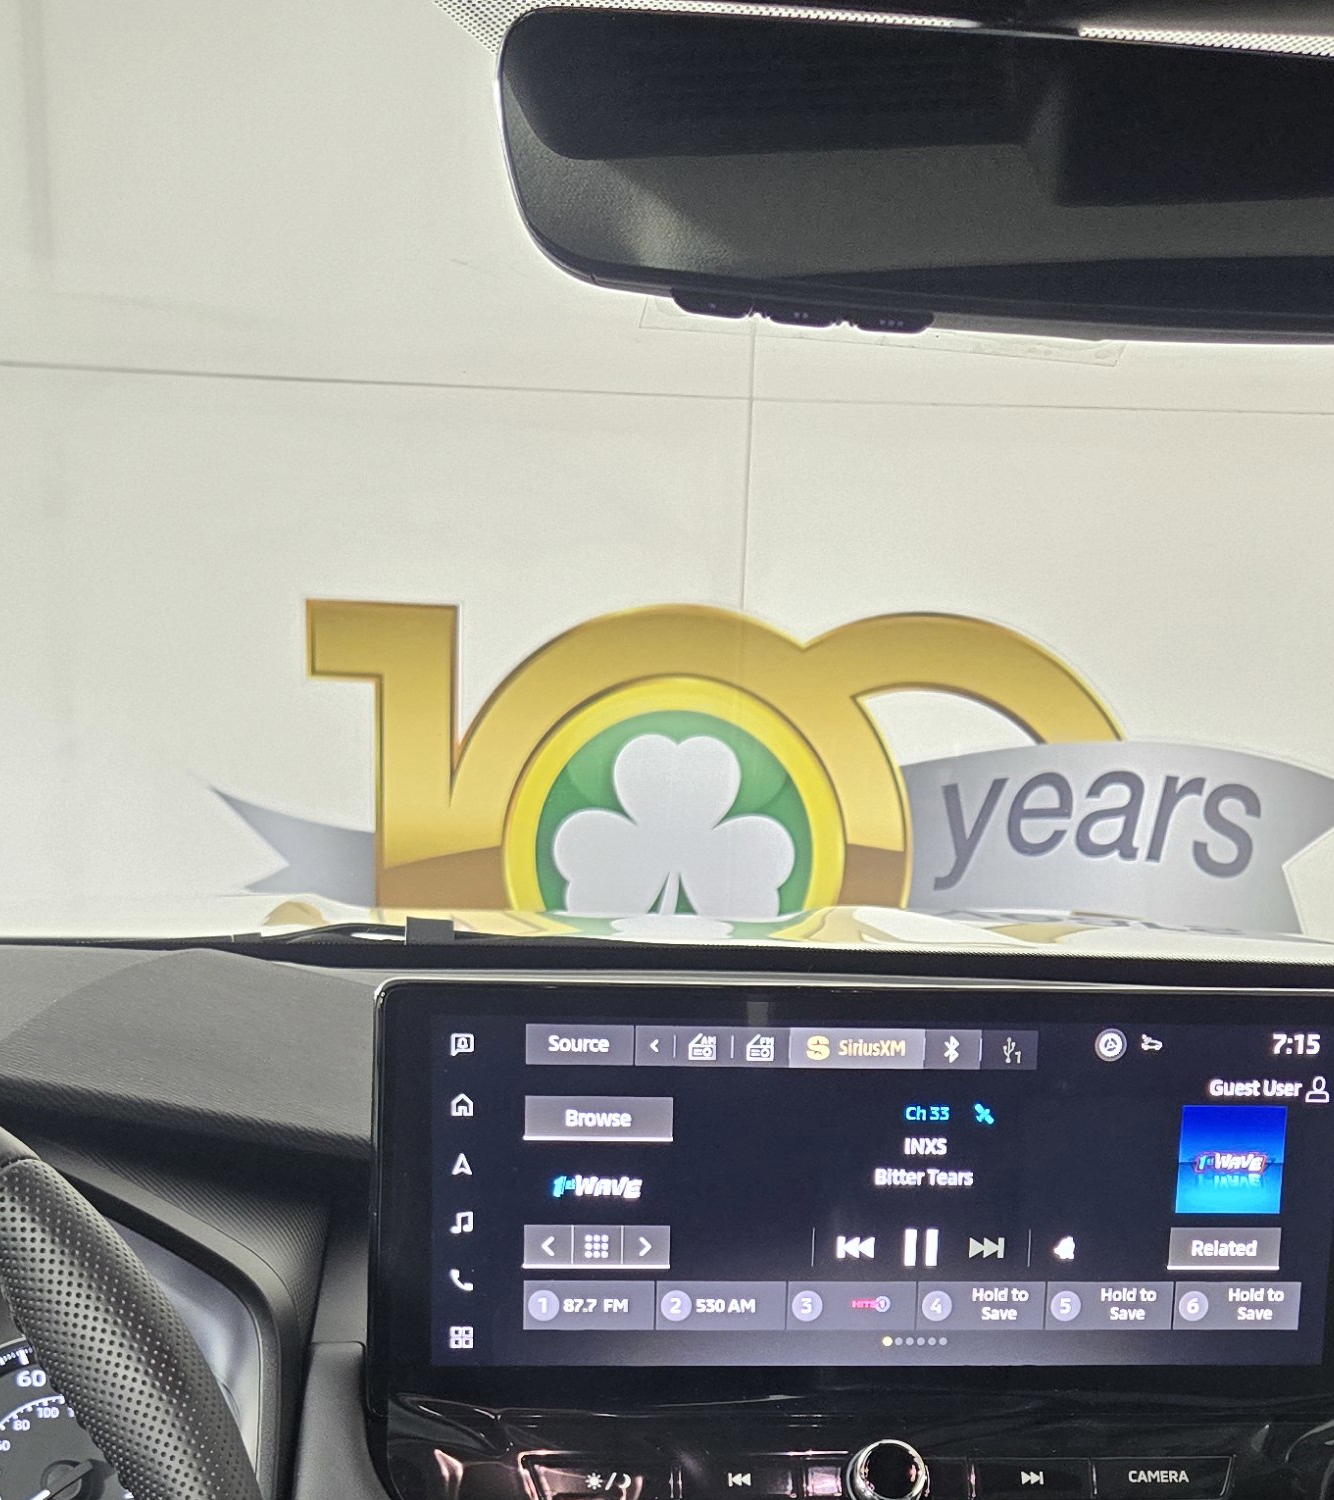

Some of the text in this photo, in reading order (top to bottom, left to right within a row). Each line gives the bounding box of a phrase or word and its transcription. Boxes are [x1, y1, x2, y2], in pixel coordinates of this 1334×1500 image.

[305, 597, 1131, 909] 100
[932, 770, 1263, 892] years
[548, 1034, 610, 1053] Source
[838, 1039, 906, 1057] SiriusXM
[1272, 1033, 1321, 1055] 7:15
[1209, 1078, 1303, 1097] Guest User
[565, 1109, 632, 1128] Browse
[905, 1105, 950, 1121] Ch 33
[904, 1137, 948, 1155] INXS
[874, 1168, 974, 1186] Bitter Tears
[1190, 1239, 1258, 1257] Related
[972, 1287, 1030, 1302] Hold to
[1100, 1287, 1157, 1302] Hold to
[1228, 1287, 1285, 1302] Hold to
[562, 1298, 597, 1313] 87.7
[603, 1298, 629, 1313] FM
[695, 1298, 726, 1313] 530
[727, 1298, 756, 1313] AM
[981, 1306, 1018, 1321] Save
[1109, 1306, 1146, 1321] Save
[1237, 1306, 1273, 1321] Save
[16, 1369, 47, 1388] 60
[36, 1406, 60, 1419] 100
[13, 1419, 31, 1432] 80
[1128, 1470, 1190, 1484] CAMERA
